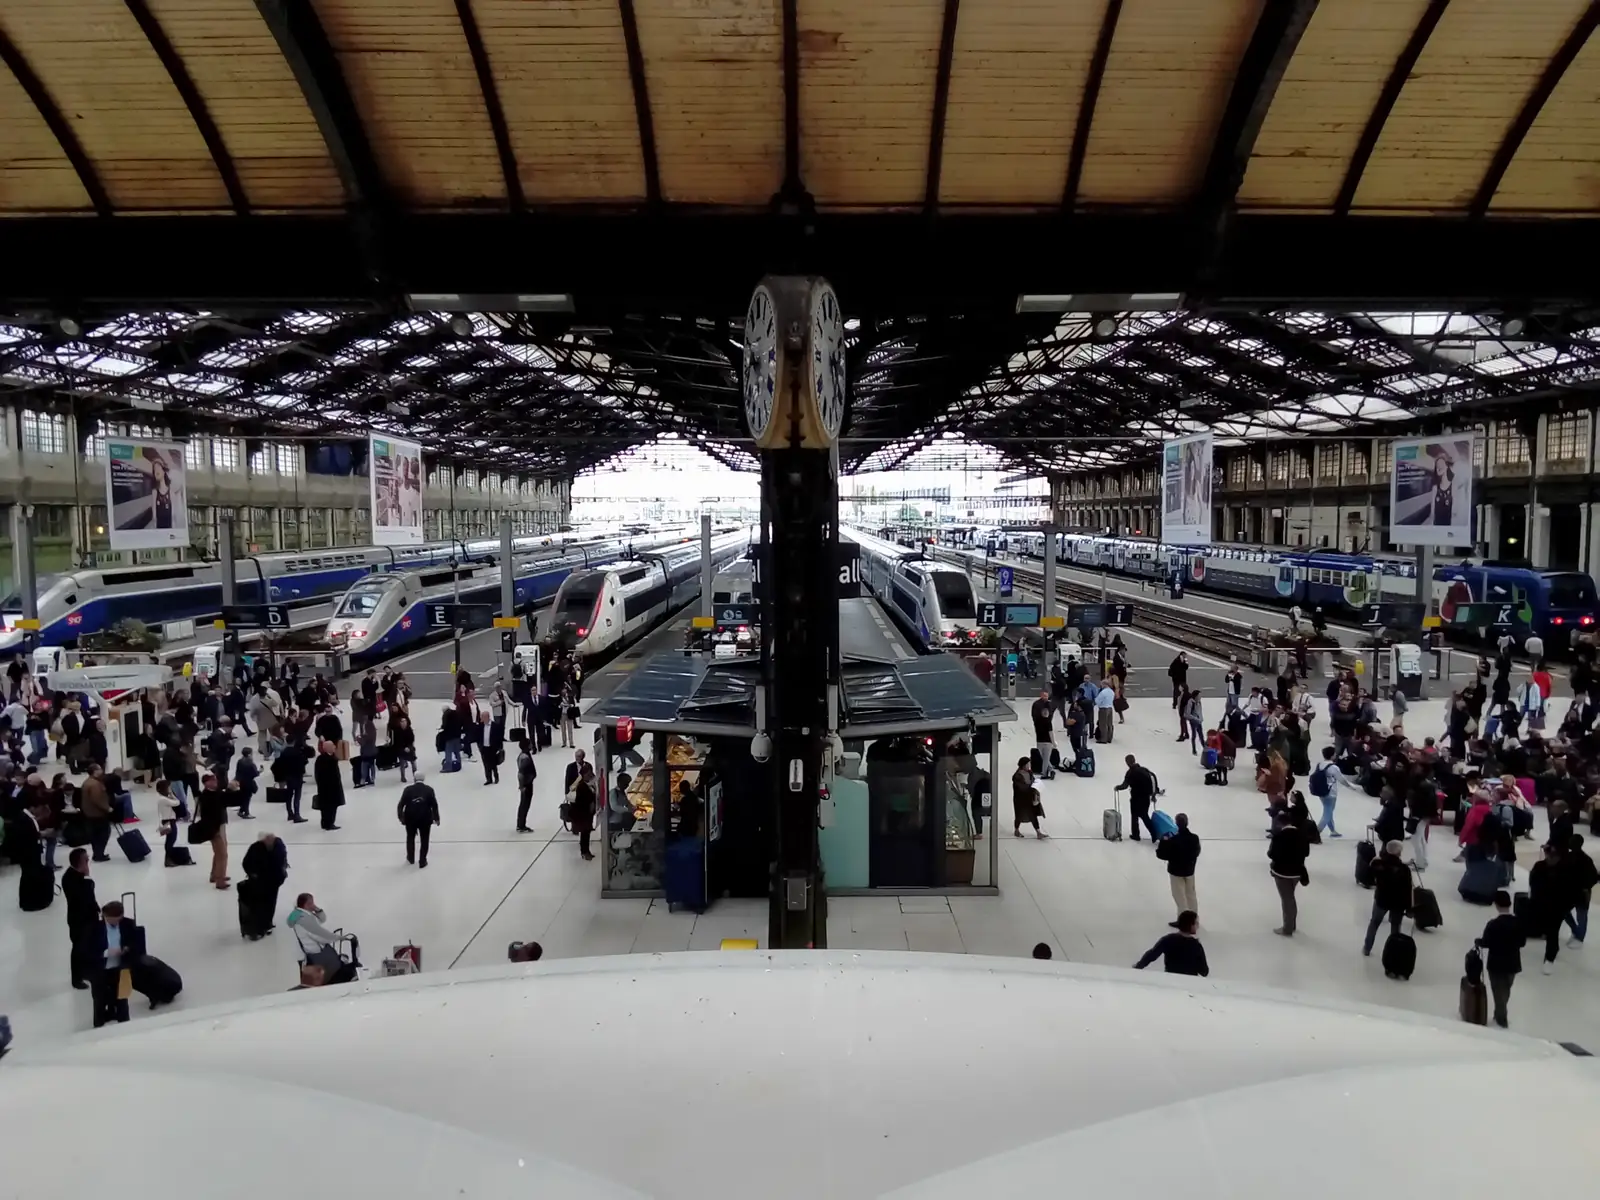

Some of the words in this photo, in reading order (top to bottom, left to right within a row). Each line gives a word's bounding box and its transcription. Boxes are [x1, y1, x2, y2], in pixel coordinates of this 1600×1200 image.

[1002, 570, 1009, 585] 9
[268, 611, 282, 625] D
[435, 611, 447, 624] E
[983, 610, 996, 623] H
[1368, 610, 1379, 623] J
[1497, 609, 1511, 623] K
